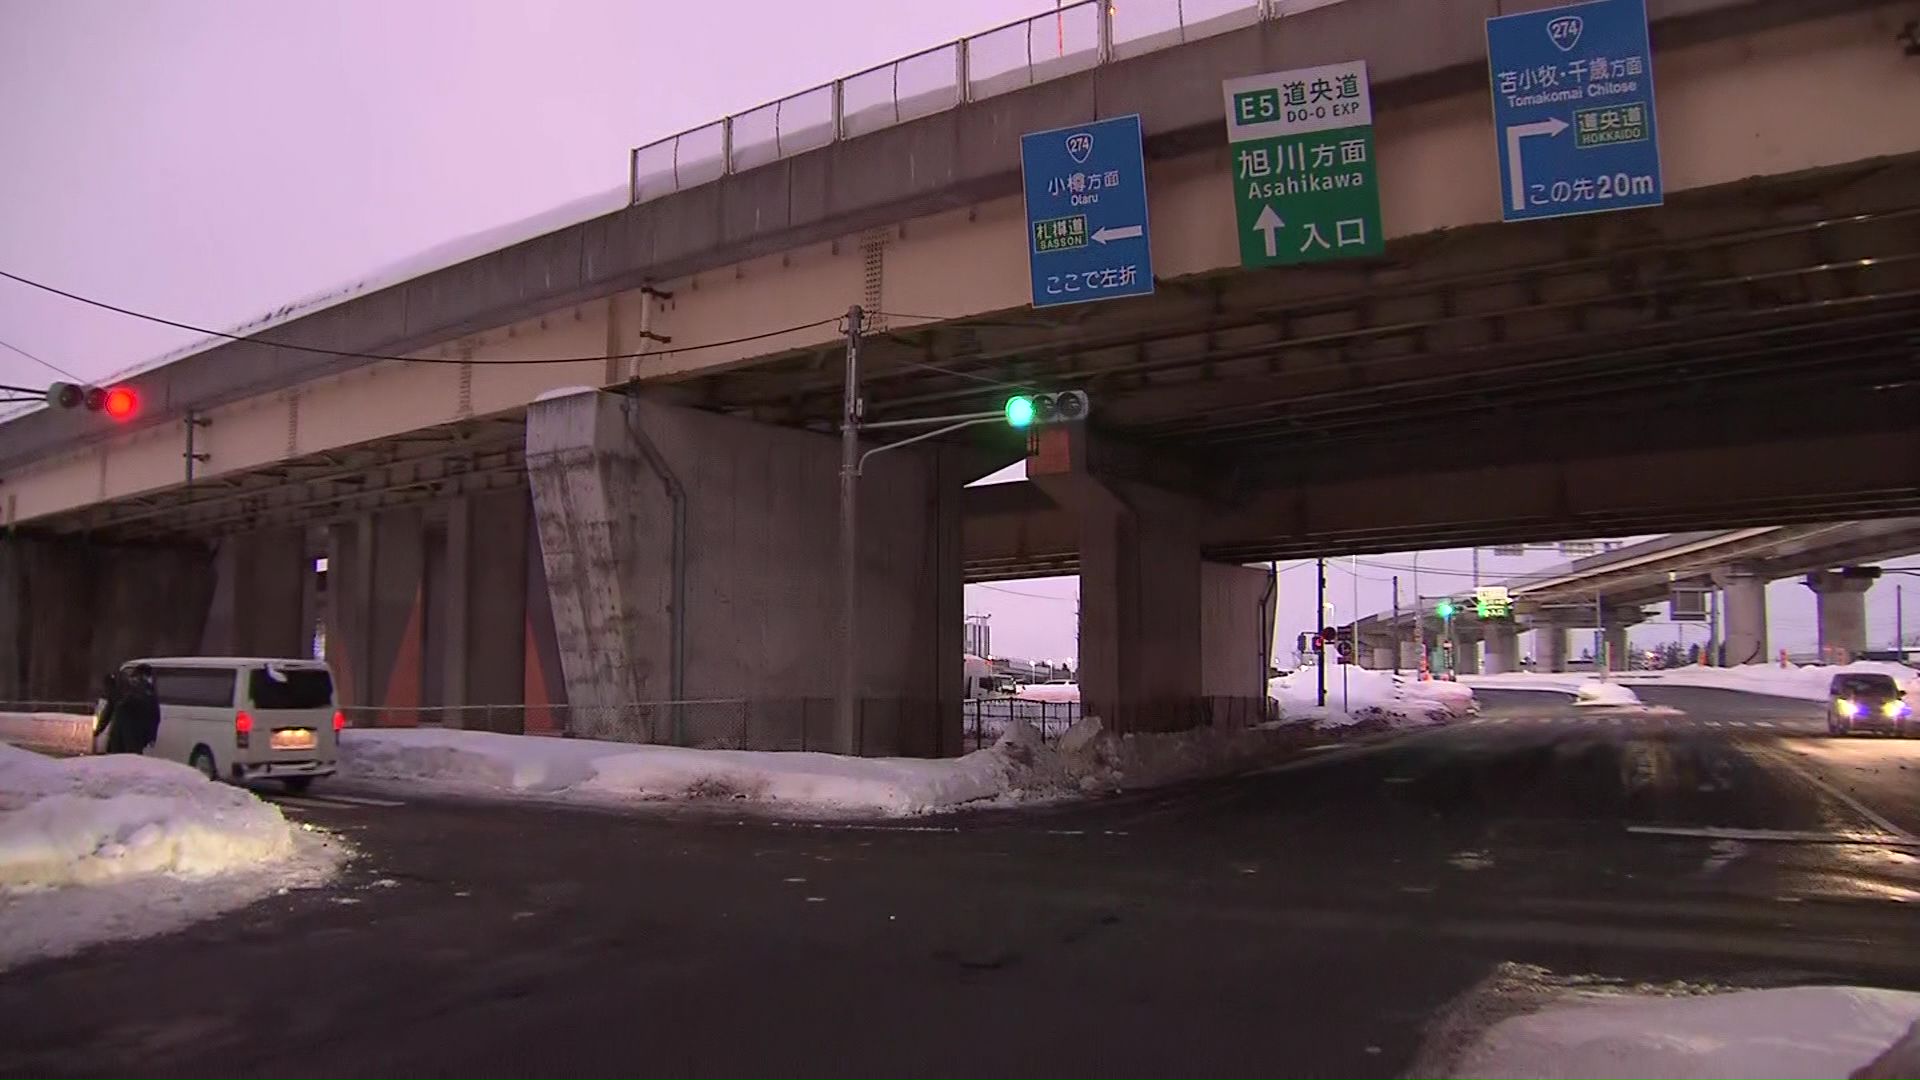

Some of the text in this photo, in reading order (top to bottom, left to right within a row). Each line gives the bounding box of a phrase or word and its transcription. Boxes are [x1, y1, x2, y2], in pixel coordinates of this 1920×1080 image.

[1551, 21, 1578, 38] 274
[1283, 73, 1360, 107] 道央道
[1508, 80, 1637, 108] Tomakomai Chitose
[1241, 95, 1274, 119] E5
[1287, 102, 1360, 123] DO-O EXP
[1578, 107, 1642, 132] 道央道
[1069, 138, 1090, 152] 274
[1582, 128, 1641, 144] HOKKAIDO
[1238, 139, 1367, 179] 旭川方面
[1249, 172, 1364, 200] Asahikawa
[1071, 194, 1099, 206] Otaru
[1040, 235, 1083, 250] SASSON
[1300, 218, 1366, 252] 入口
[1047, 265, 1137, 294] ここで左折
